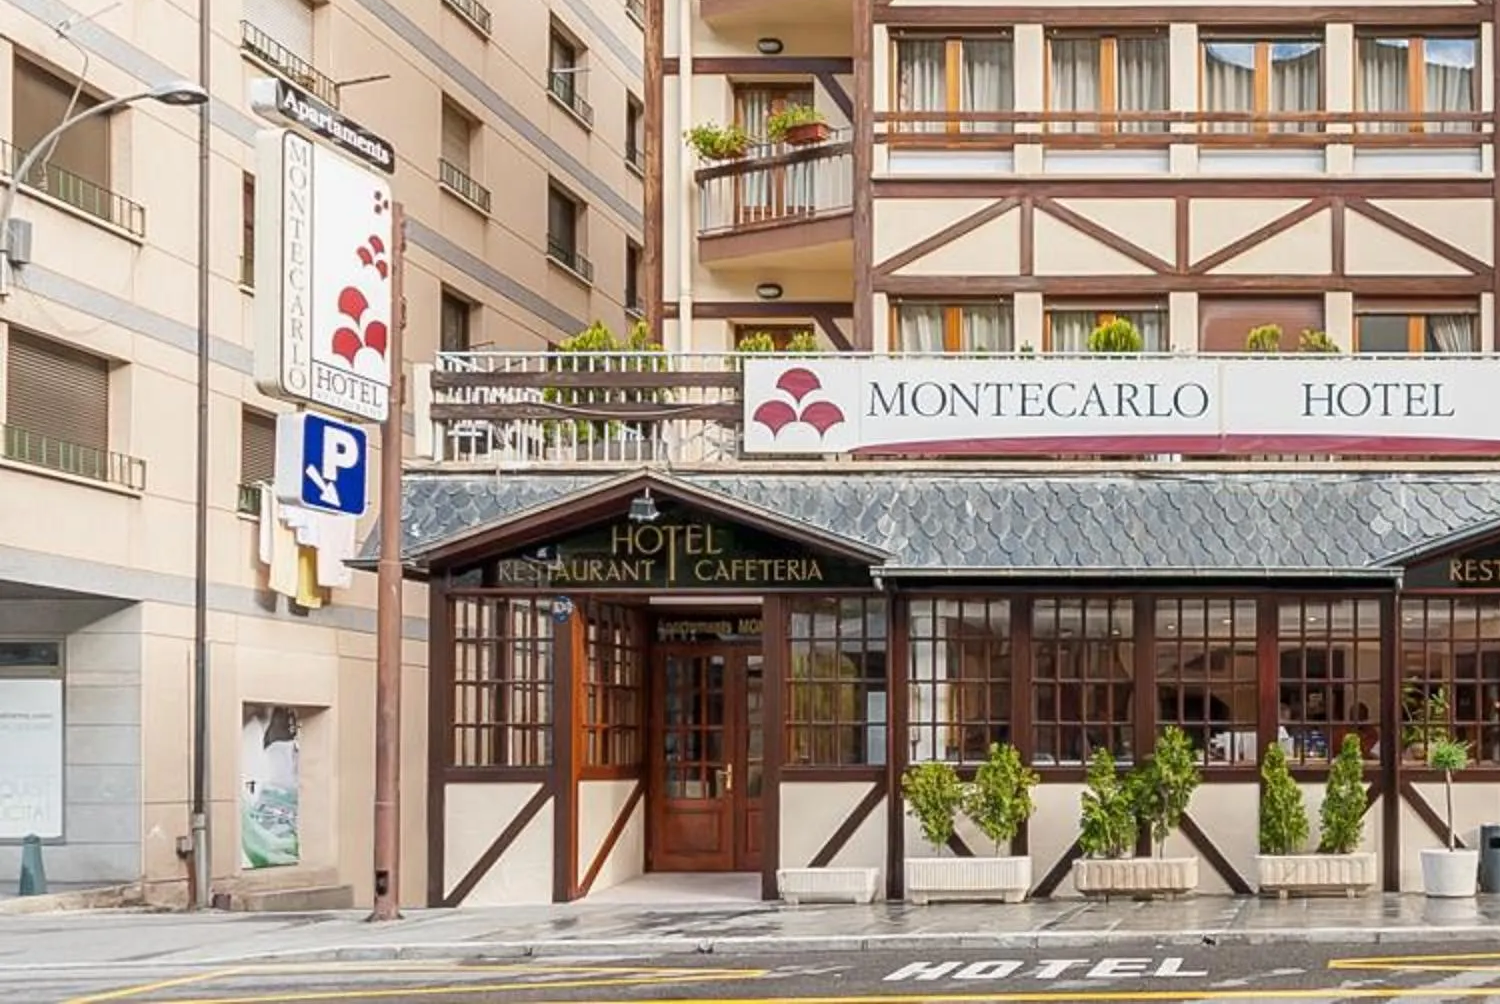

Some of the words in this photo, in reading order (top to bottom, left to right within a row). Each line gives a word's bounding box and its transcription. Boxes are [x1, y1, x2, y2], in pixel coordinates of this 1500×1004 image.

[284, 89, 391, 165] Apartaments
[289, 140, 307, 391] MONTECARLO
[317, 366, 383, 407] HOTEL
[867, 381, 1210, 419] MONTECARLO
[1301, 382, 1455, 418] HOTEL
[323, 425, 359, 481] P
[499, 559, 656, 582] RESTAURANT
[694, 559, 823, 581] CAFETERIA
[611, 523, 723, 581] HOTEL
[883, 957, 1209, 981] HOTEL
